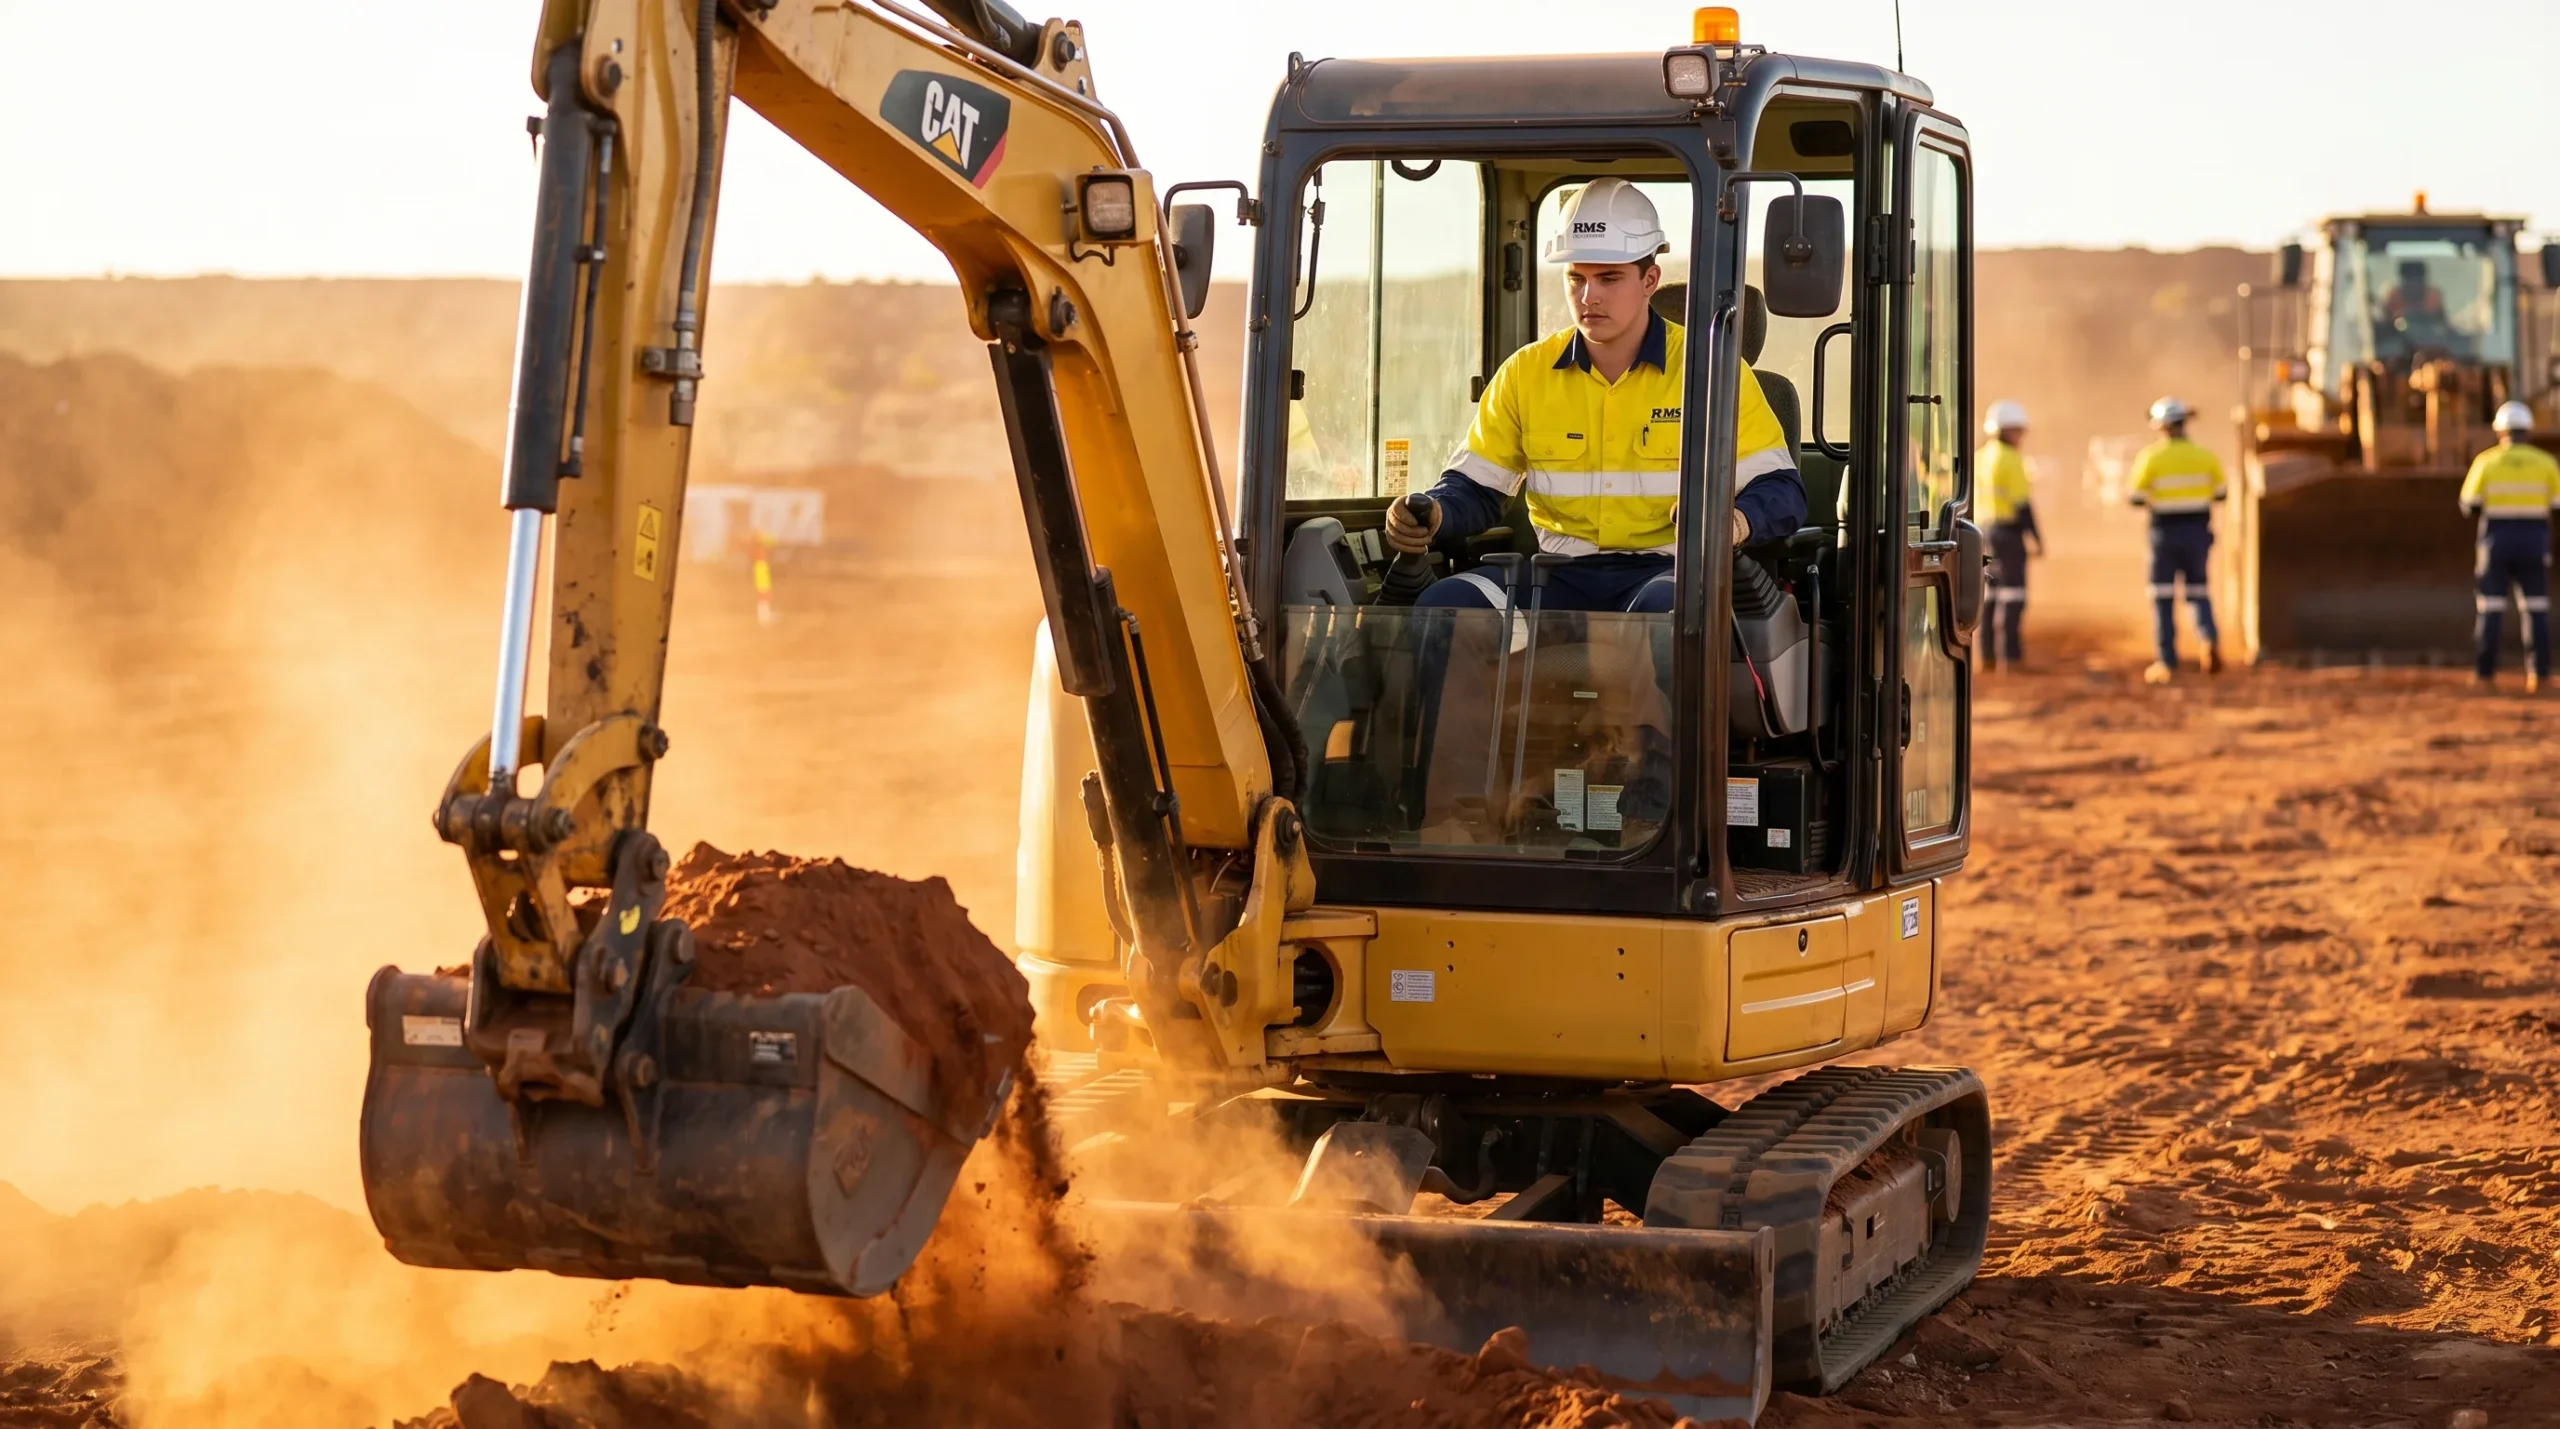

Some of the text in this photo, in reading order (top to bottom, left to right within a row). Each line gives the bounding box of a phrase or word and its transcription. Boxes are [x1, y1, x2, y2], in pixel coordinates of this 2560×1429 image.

[921, 80, 980, 170] CAT
[1573, 222, 1606, 233] RMS
[1651, 408, 1681, 418] RMS
